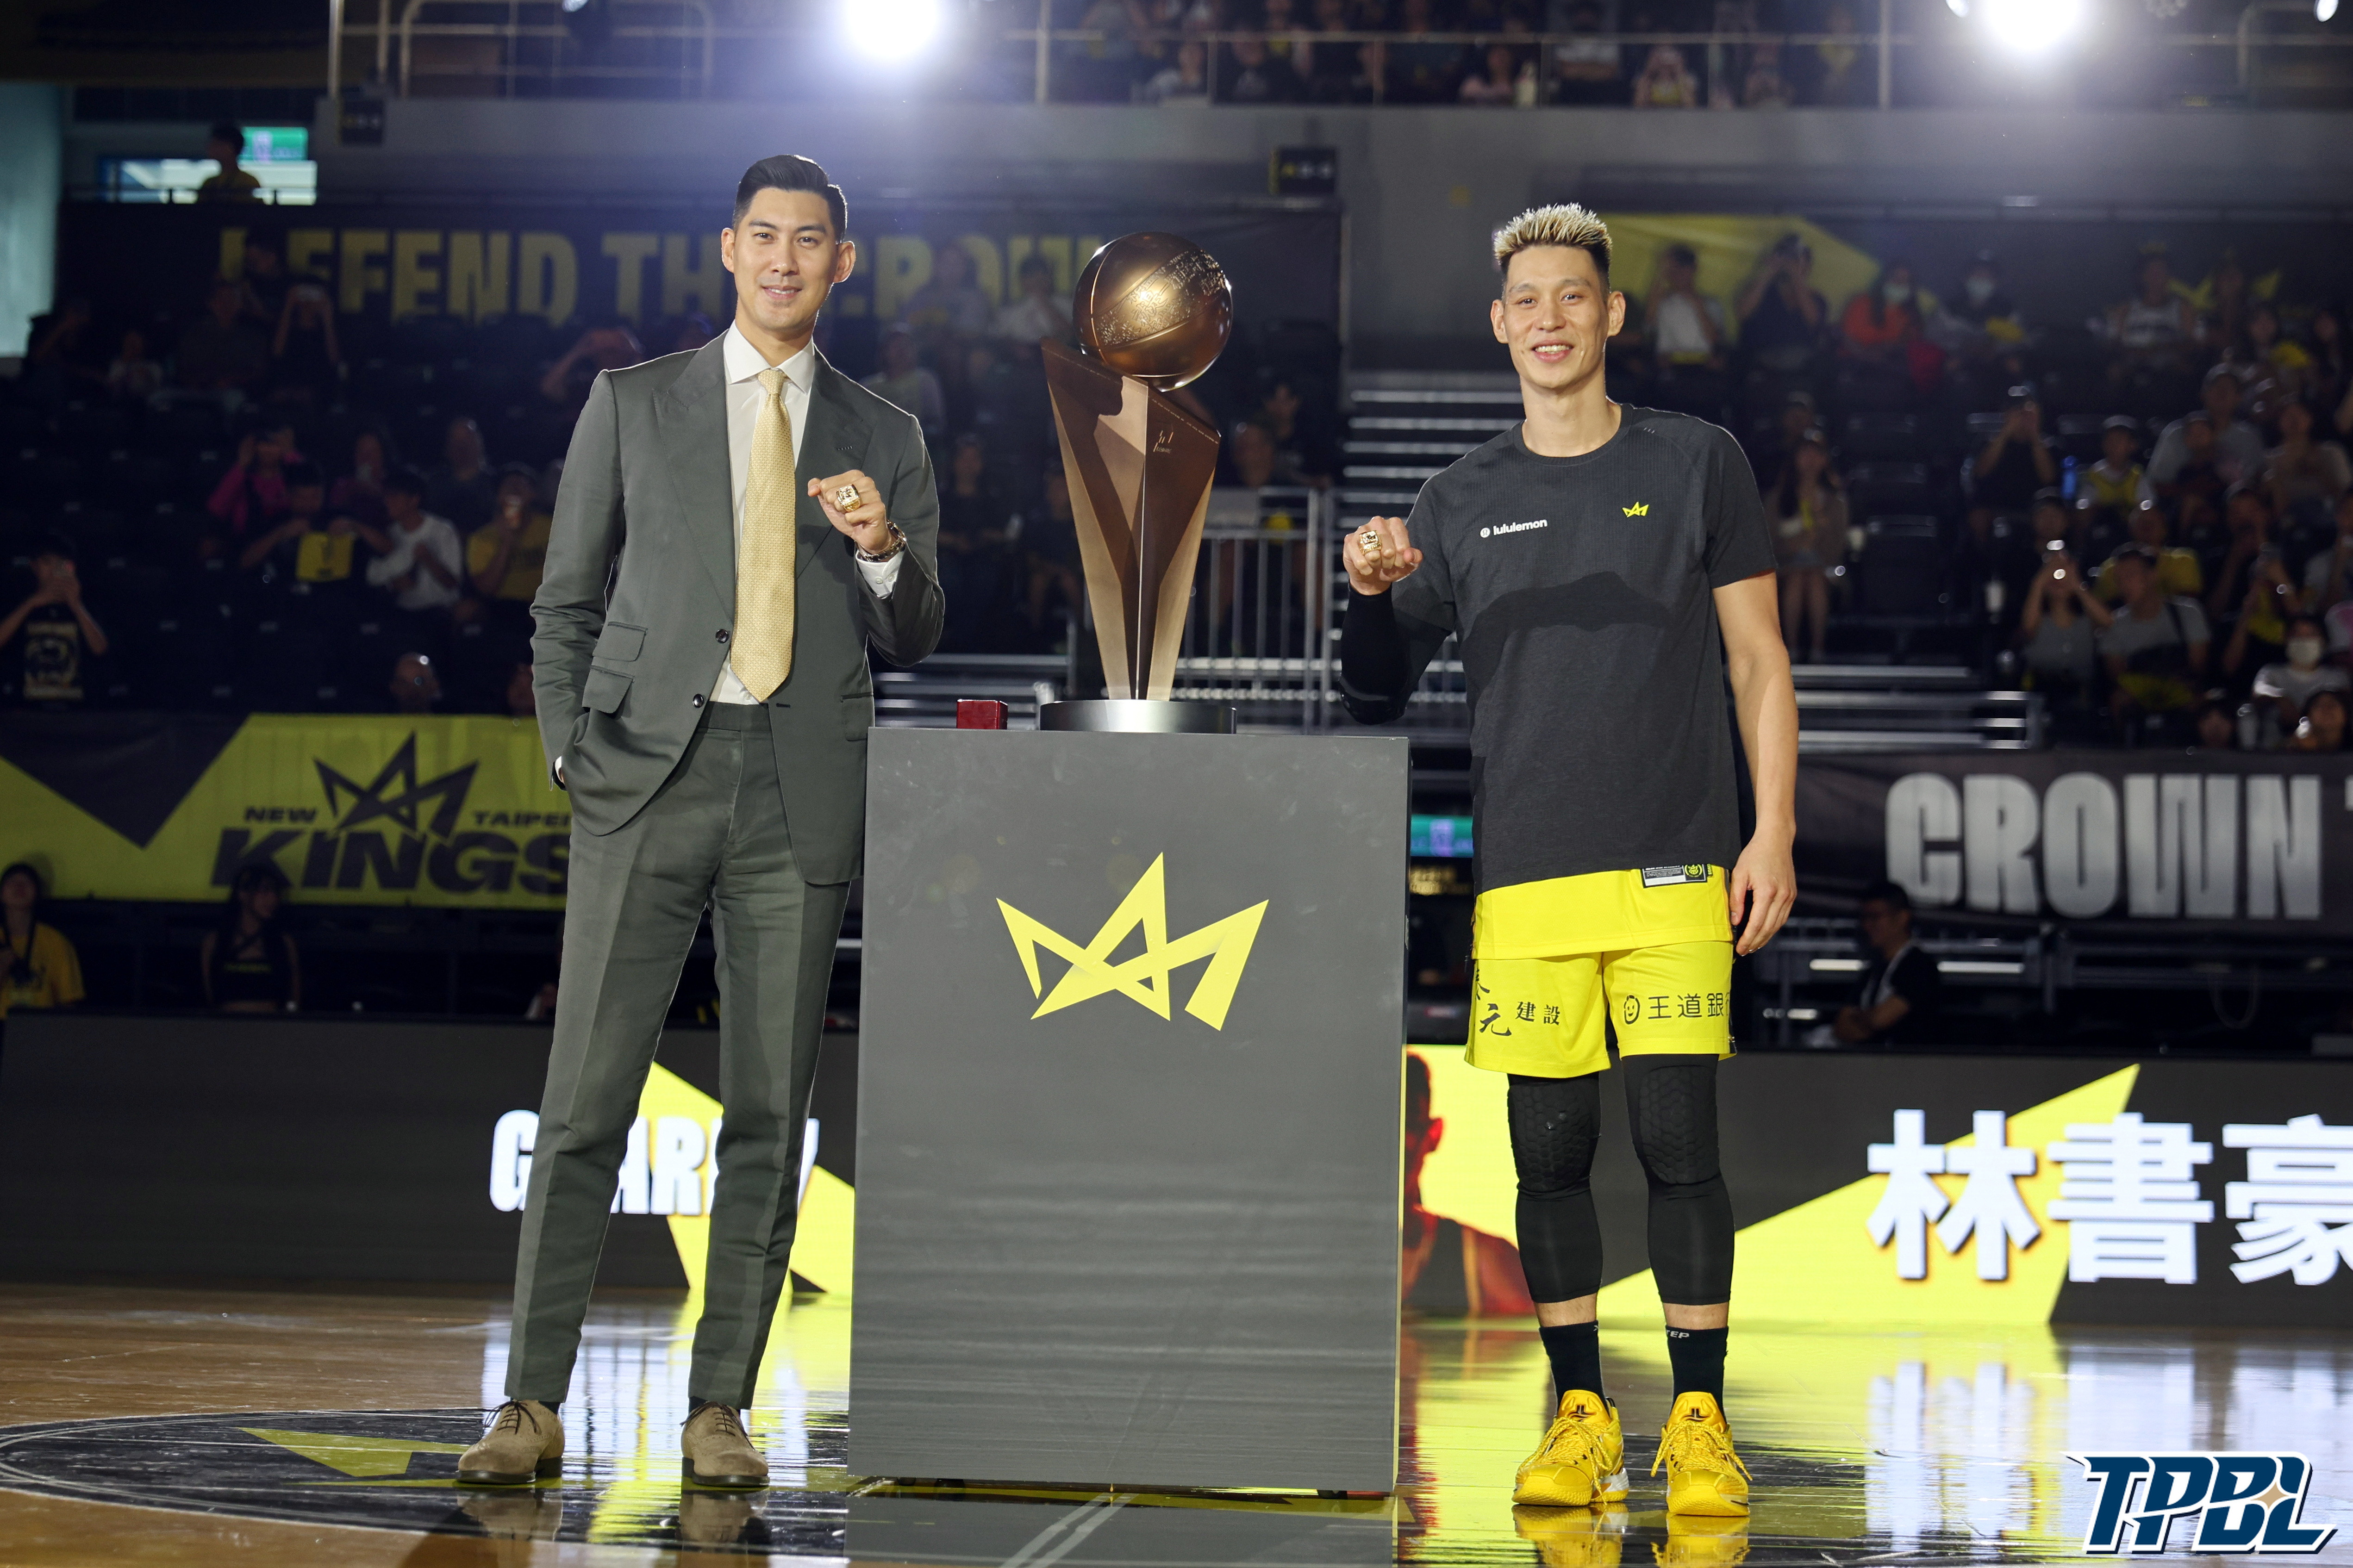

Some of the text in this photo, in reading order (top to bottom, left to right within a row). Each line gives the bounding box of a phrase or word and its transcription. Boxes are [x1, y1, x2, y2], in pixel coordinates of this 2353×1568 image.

[1493, 519, 1548, 535] lululemon
[243, 806, 570, 828] NEW TAIPEI
[1885, 772, 2322, 919] CROWN
[211, 828, 572, 897] KINGS
[1866, 1108, 2353, 1286] 林書豪
